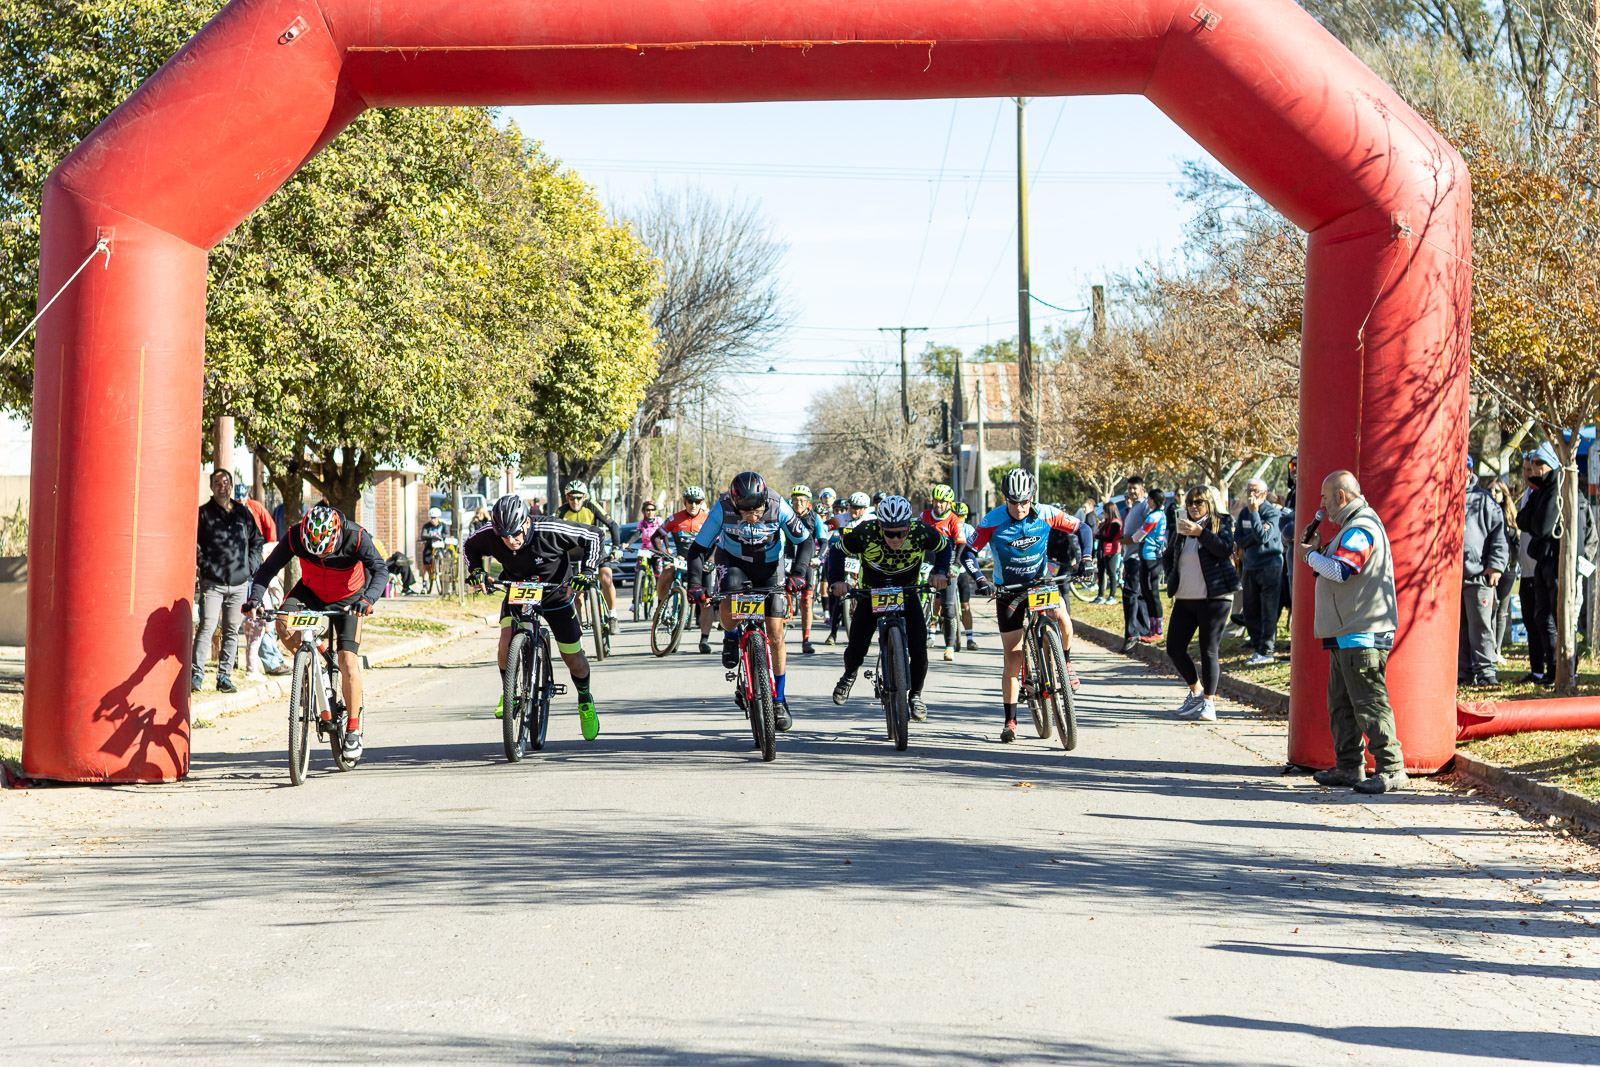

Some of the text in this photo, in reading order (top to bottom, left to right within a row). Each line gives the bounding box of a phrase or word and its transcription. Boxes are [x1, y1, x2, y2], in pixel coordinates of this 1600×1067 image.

[514, 588, 537, 599] 35
[1036, 593, 1051, 605] 51
[877, 594, 899, 607] 93
[736, 601, 762, 614] 167
[292, 616, 320, 626] 160
